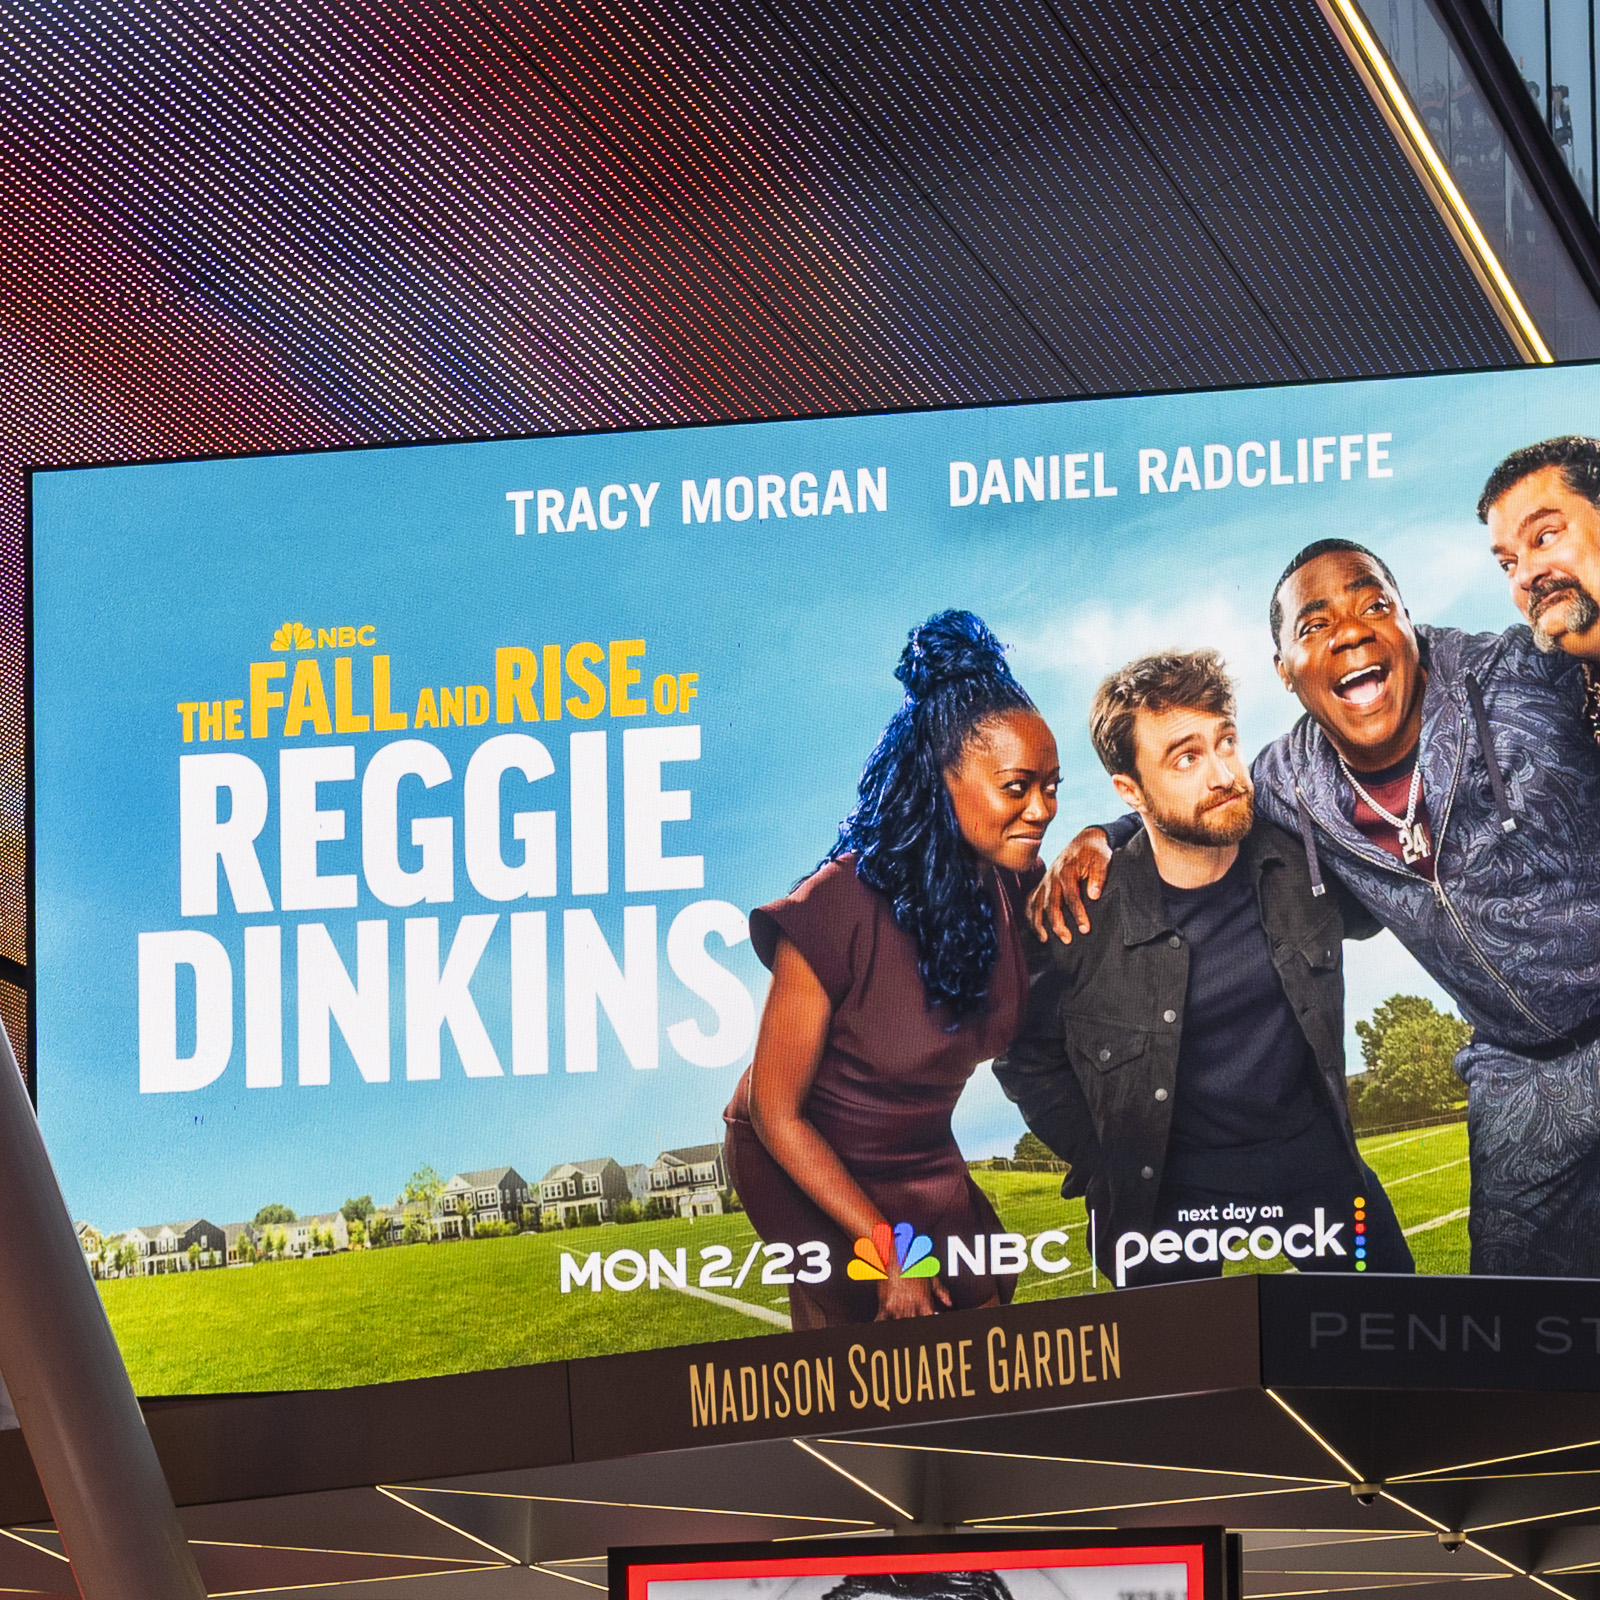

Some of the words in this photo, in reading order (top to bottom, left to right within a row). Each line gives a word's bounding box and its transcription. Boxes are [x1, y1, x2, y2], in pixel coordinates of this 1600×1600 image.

[506, 482, 660, 535] TRACY
[681, 466, 887, 525] MORGAN
[949, 451, 1118, 507] DANIEL
[1139, 432, 1394, 495] RADCLIFFE
[317, 625, 377, 649] NBC
[176, 700, 244, 743] THE
[249, 655, 408, 739] FALL
[413, 685, 489, 729] AND
[496, 639, 647, 724] RISE
[653, 672, 698, 715] OF
[178, 724, 704, 917] REGGIE
[1399, 822, 1431, 865] 24
[137, 899, 756, 1095] DINKINS
[560, 1247, 688, 1294] MON
[699, 1241, 833, 1290] 2/23
[946, 1230, 1072, 1277] NBC
[1115, 1207, 1348, 1288] peacock
[1177, 1205, 1216, 1222] next
[1218, 1204, 1256, 1224] day
[1260, 1205, 1284, 1219] on
[689, 1356, 835, 1428] MADISON
[848, 1340, 976, 1412] SQUARE
[987, 1322, 1122, 1395] GARDEN
[1309, 1311, 1501, 1352] PENN
